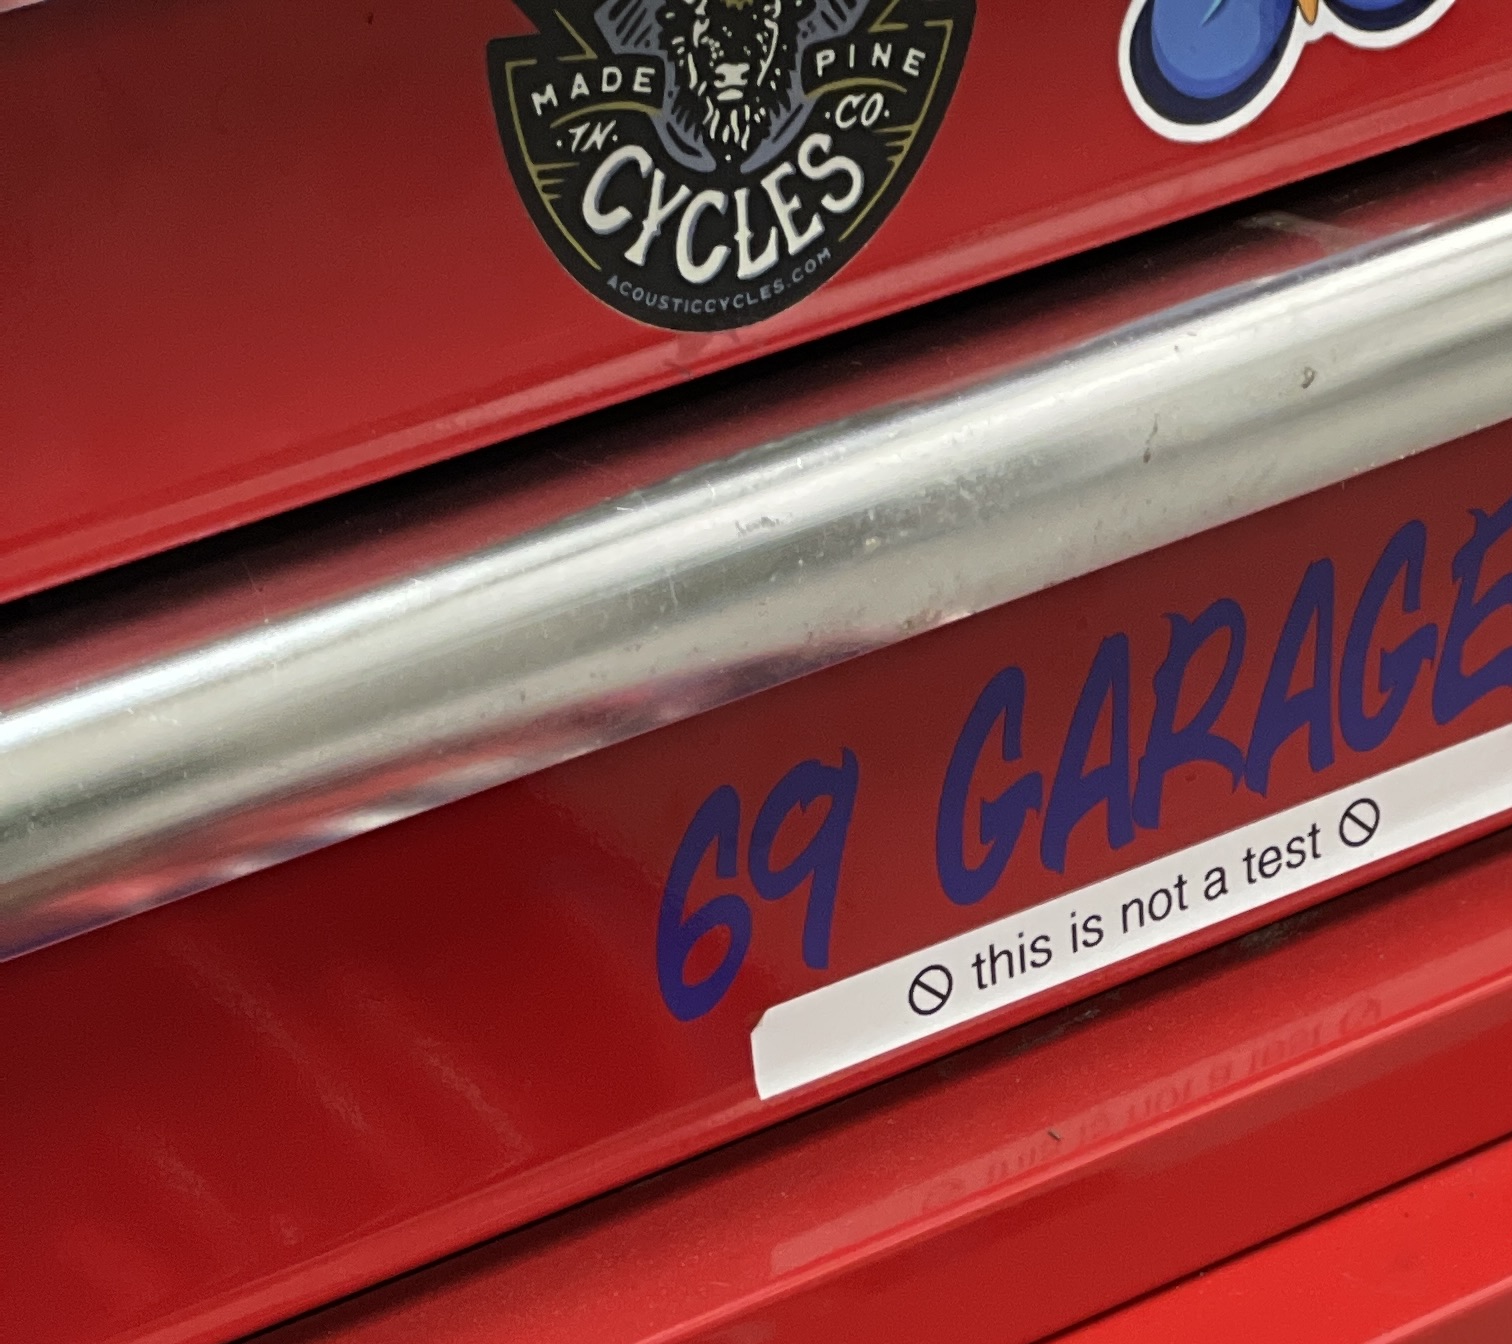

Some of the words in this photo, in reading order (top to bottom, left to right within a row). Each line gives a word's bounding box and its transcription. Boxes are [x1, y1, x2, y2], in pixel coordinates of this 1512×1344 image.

[532, 67, 656, 115] MADE
[816, 43, 925, 77] PINE
[582, 132, 865, 284] CYCLES
[606, 247, 833, 314] ACOUSTICCYCLES.COM
[656, 747, 859, 1022] 69
[972, 929, 1053, 992] this
[1069, 909, 1105, 956] is
[1121, 873, 1189, 933] not
[1204, 866, 1230, 901] a
[1243, 821, 1321, 887] test
